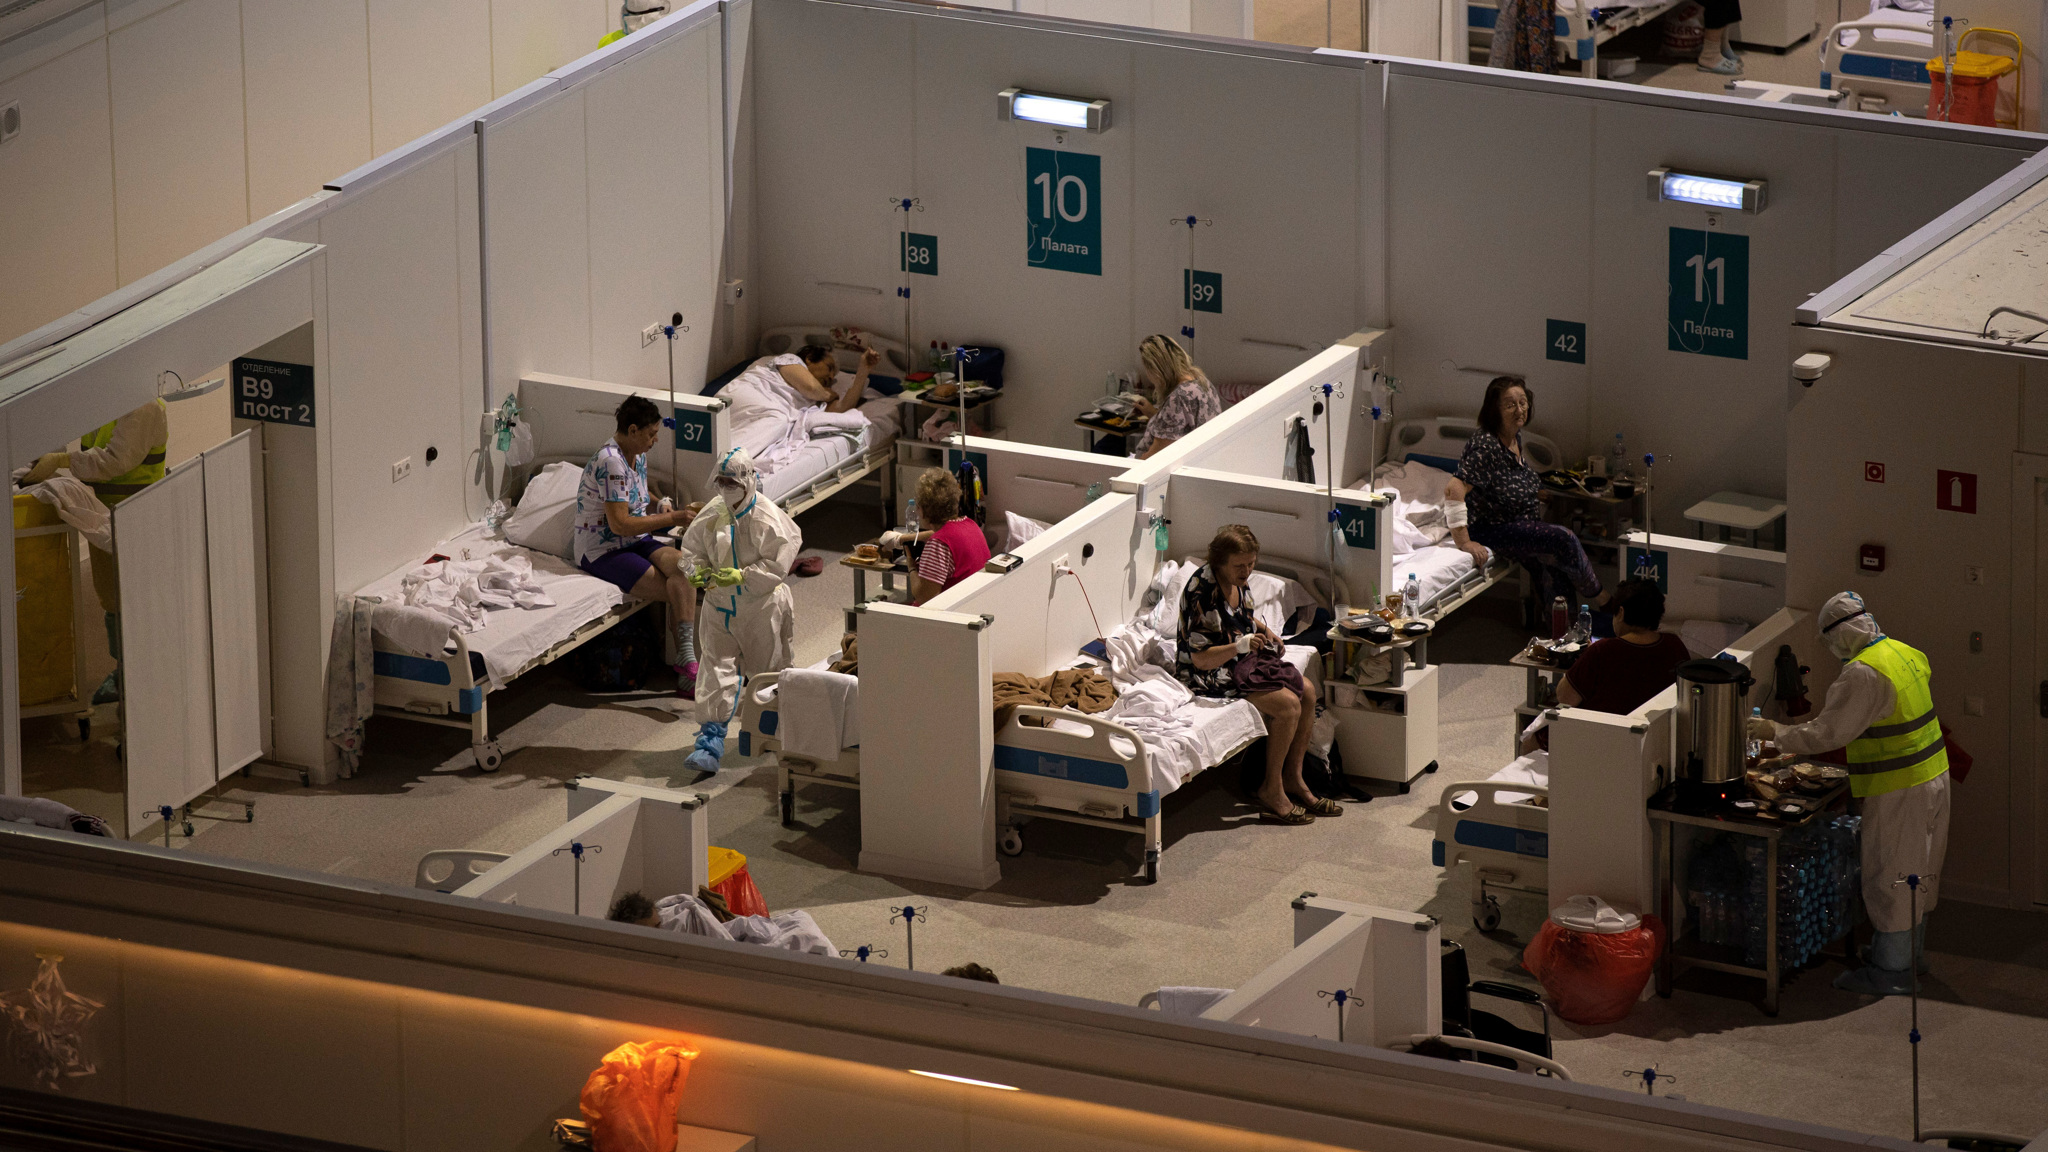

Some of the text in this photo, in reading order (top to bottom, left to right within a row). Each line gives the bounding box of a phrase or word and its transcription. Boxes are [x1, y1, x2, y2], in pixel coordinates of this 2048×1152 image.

[1033, 172, 1088, 223] 10
[908, 245, 930, 265] 38
[1041, 236, 1089, 255] Палата
[1685, 254, 1725, 306] 11
[1192, 283, 1215, 303] 39
[1683, 319, 1735, 339] Палата
[1554, 333, 1577, 353] 42
[242, 362, 291, 376] ОТДЕЛЕНИЕ
[243, 401, 311, 423] пост 2
[683, 422, 704, 442] 37
[1345, 518, 1364, 538] 41
[1633, 563, 1660, 583] 44
